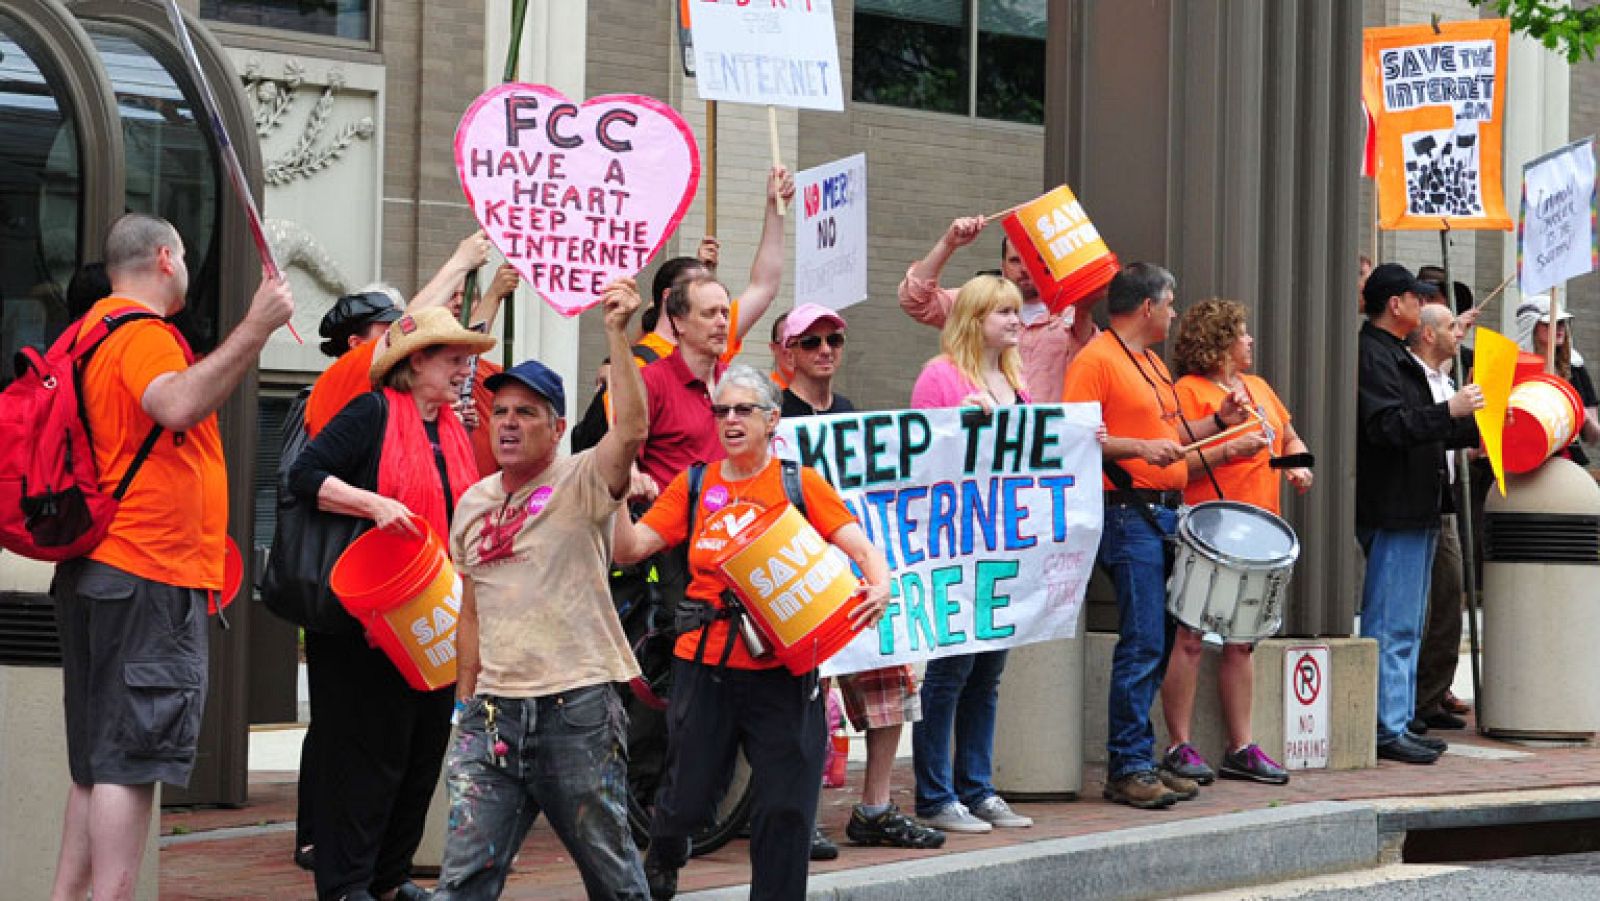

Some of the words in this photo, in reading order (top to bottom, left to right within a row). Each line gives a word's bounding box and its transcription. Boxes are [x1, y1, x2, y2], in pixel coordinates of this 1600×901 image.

[703, 51, 829, 97] INTERNET
[1383, 46, 1457, 80] SAVE
[1459, 46, 1492, 68] THE
[1385, 75, 1495, 109] INTERNET
[504, 95, 638, 152] FCC
[470, 148, 567, 180] HAVE
[604, 158, 626, 186] A
[513, 180, 630, 215] HEART
[804, 182, 821, 220] NO
[484, 200, 567, 231] KEEP
[585, 216, 648, 244] THE
[817, 216, 836, 250] NO
[502, 231, 649, 270] INTERNET
[532, 262, 607, 296] FREE
[795, 412, 932, 492] KEEP
[960, 407, 1065, 475] THE
[878, 559, 1019, 656] FREE
[1299, 713, 1315, 734] NO
[1286, 739, 1326, 758] PARKING
